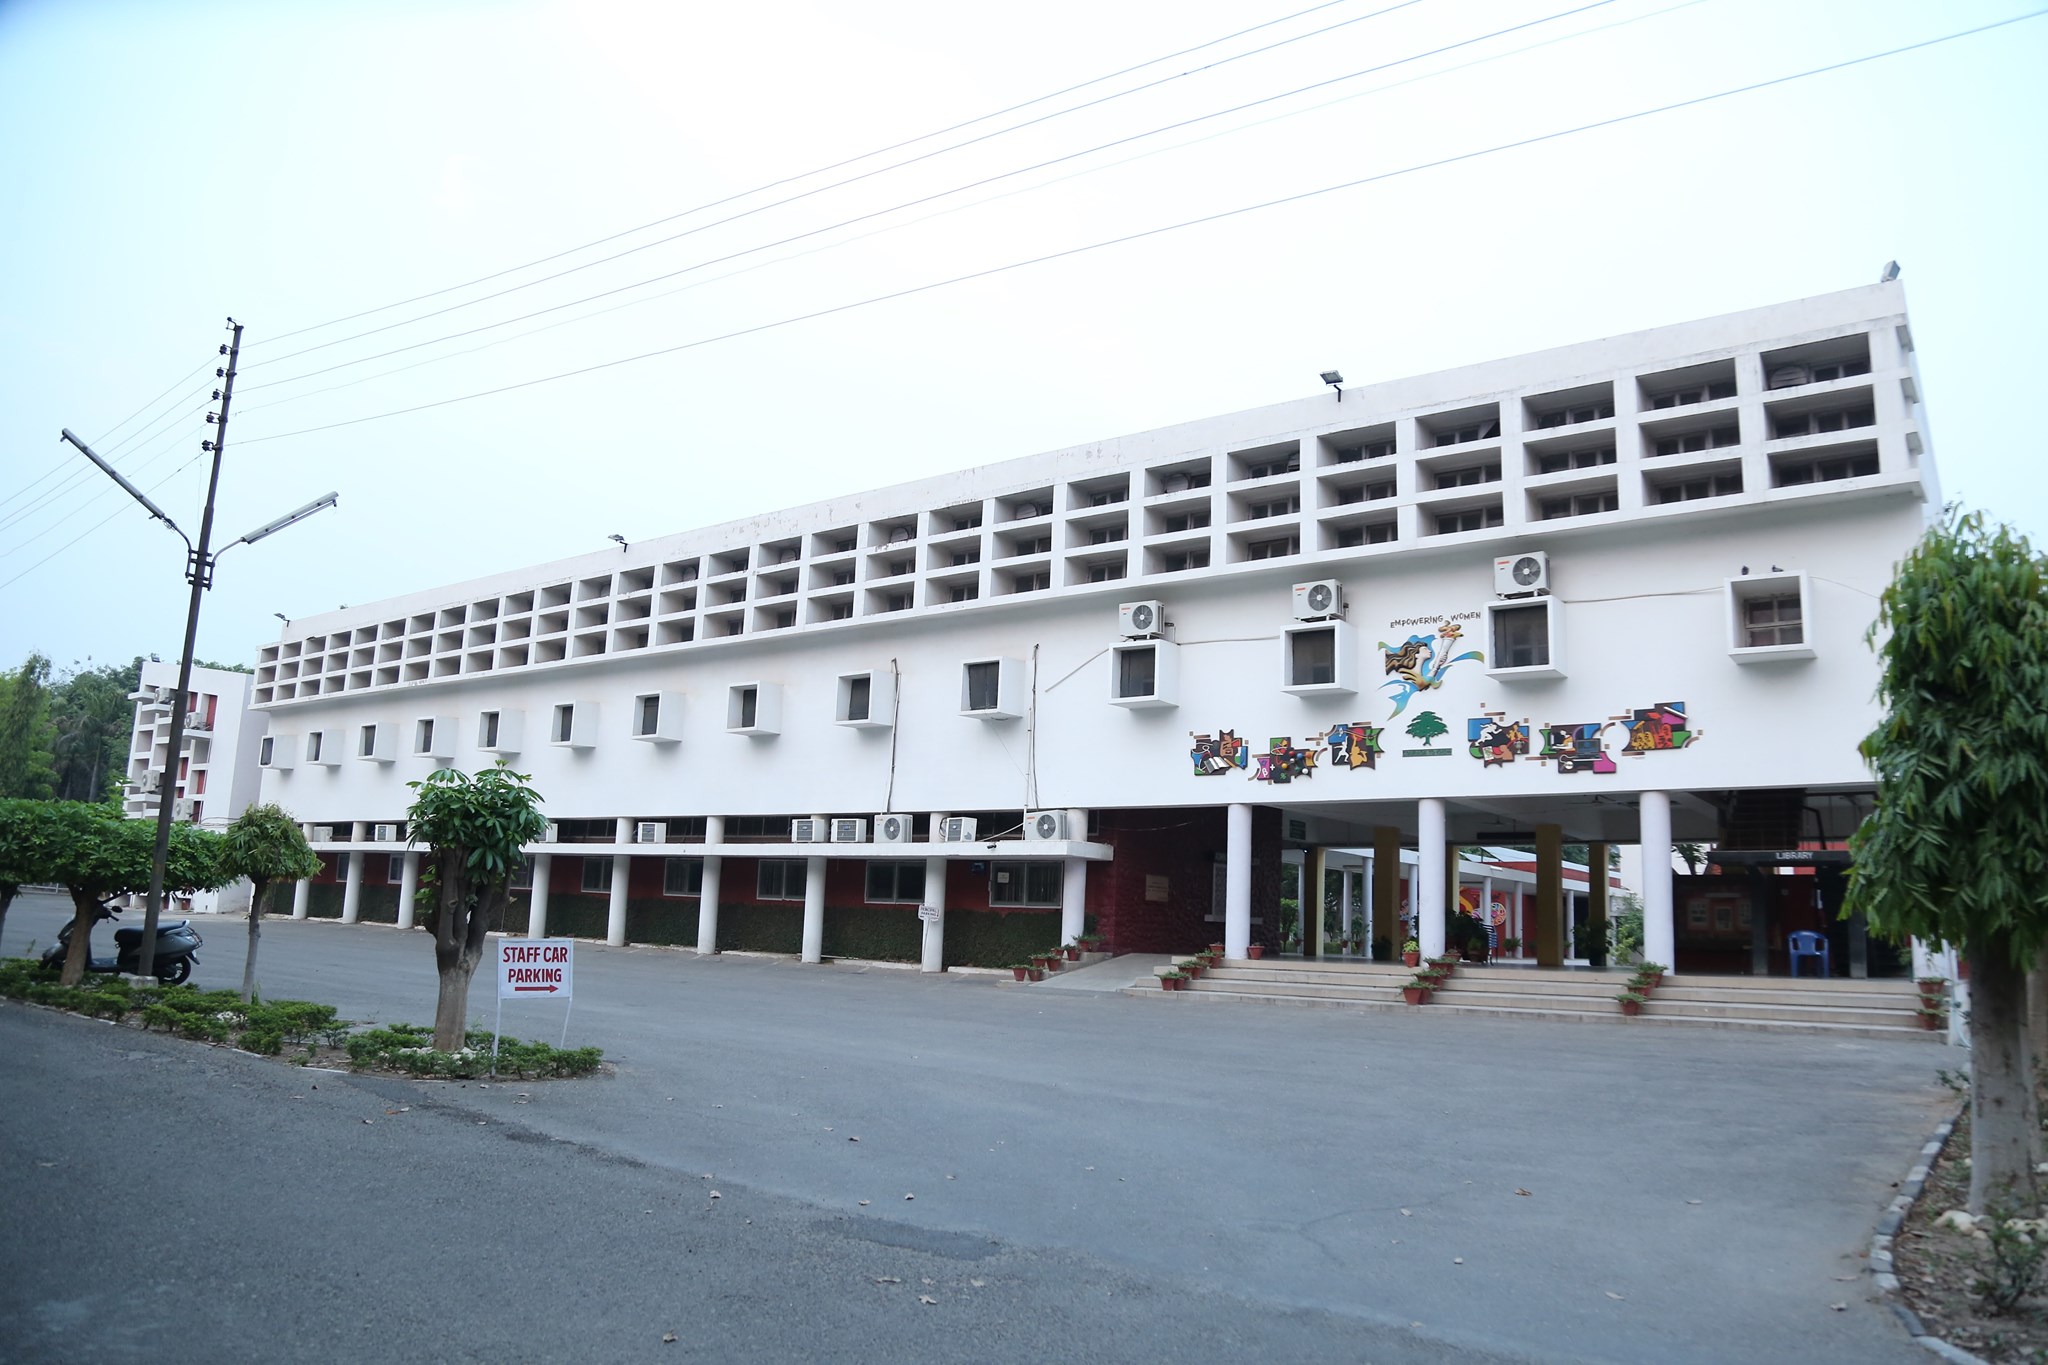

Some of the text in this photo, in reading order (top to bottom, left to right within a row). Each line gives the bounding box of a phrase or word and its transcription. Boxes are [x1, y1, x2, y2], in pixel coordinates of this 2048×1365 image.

[1390, 612, 1481, 628] EMPOWERING WOMEN
[1776, 852, 1813, 860] LIBRARY
[503, 946, 568, 963] STAFF CAR
[508, 968, 562, 983] PARKING
